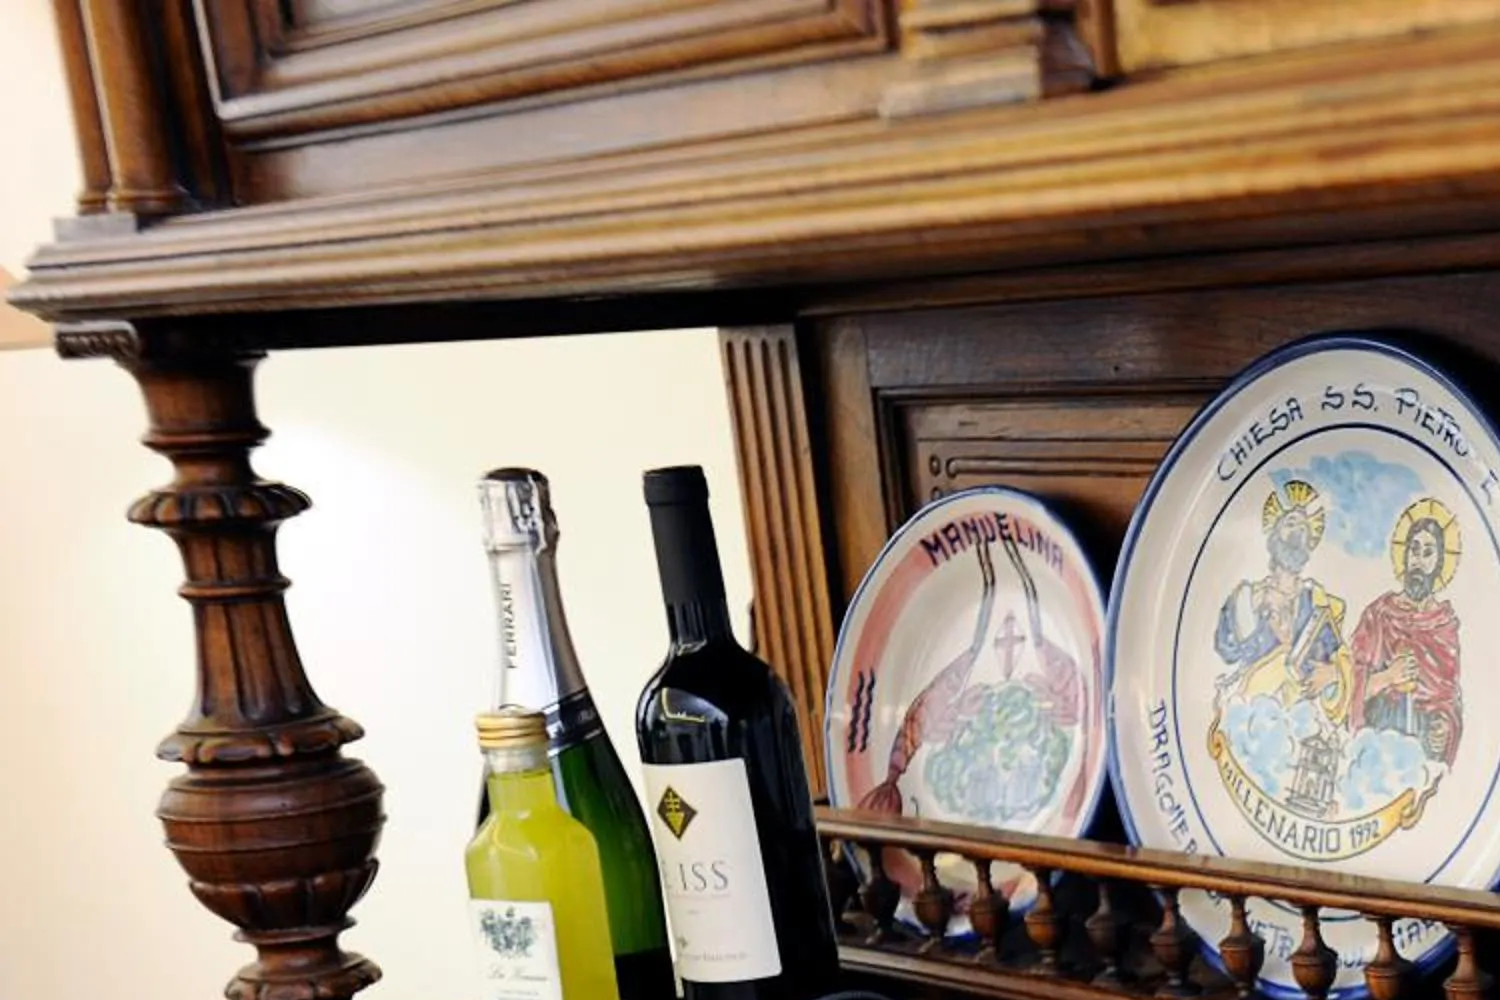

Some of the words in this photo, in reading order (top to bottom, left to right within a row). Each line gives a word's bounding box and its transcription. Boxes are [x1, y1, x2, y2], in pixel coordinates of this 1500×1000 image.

[1216, 397, 1304, 483] CHIESA
[1394, 387, 1469, 458] PIETRO
[920, 512, 1065, 574] MANUELINA
[1222, 761, 1341, 854] MILLENARIO
[1350, 820, 1380, 849] 1992
